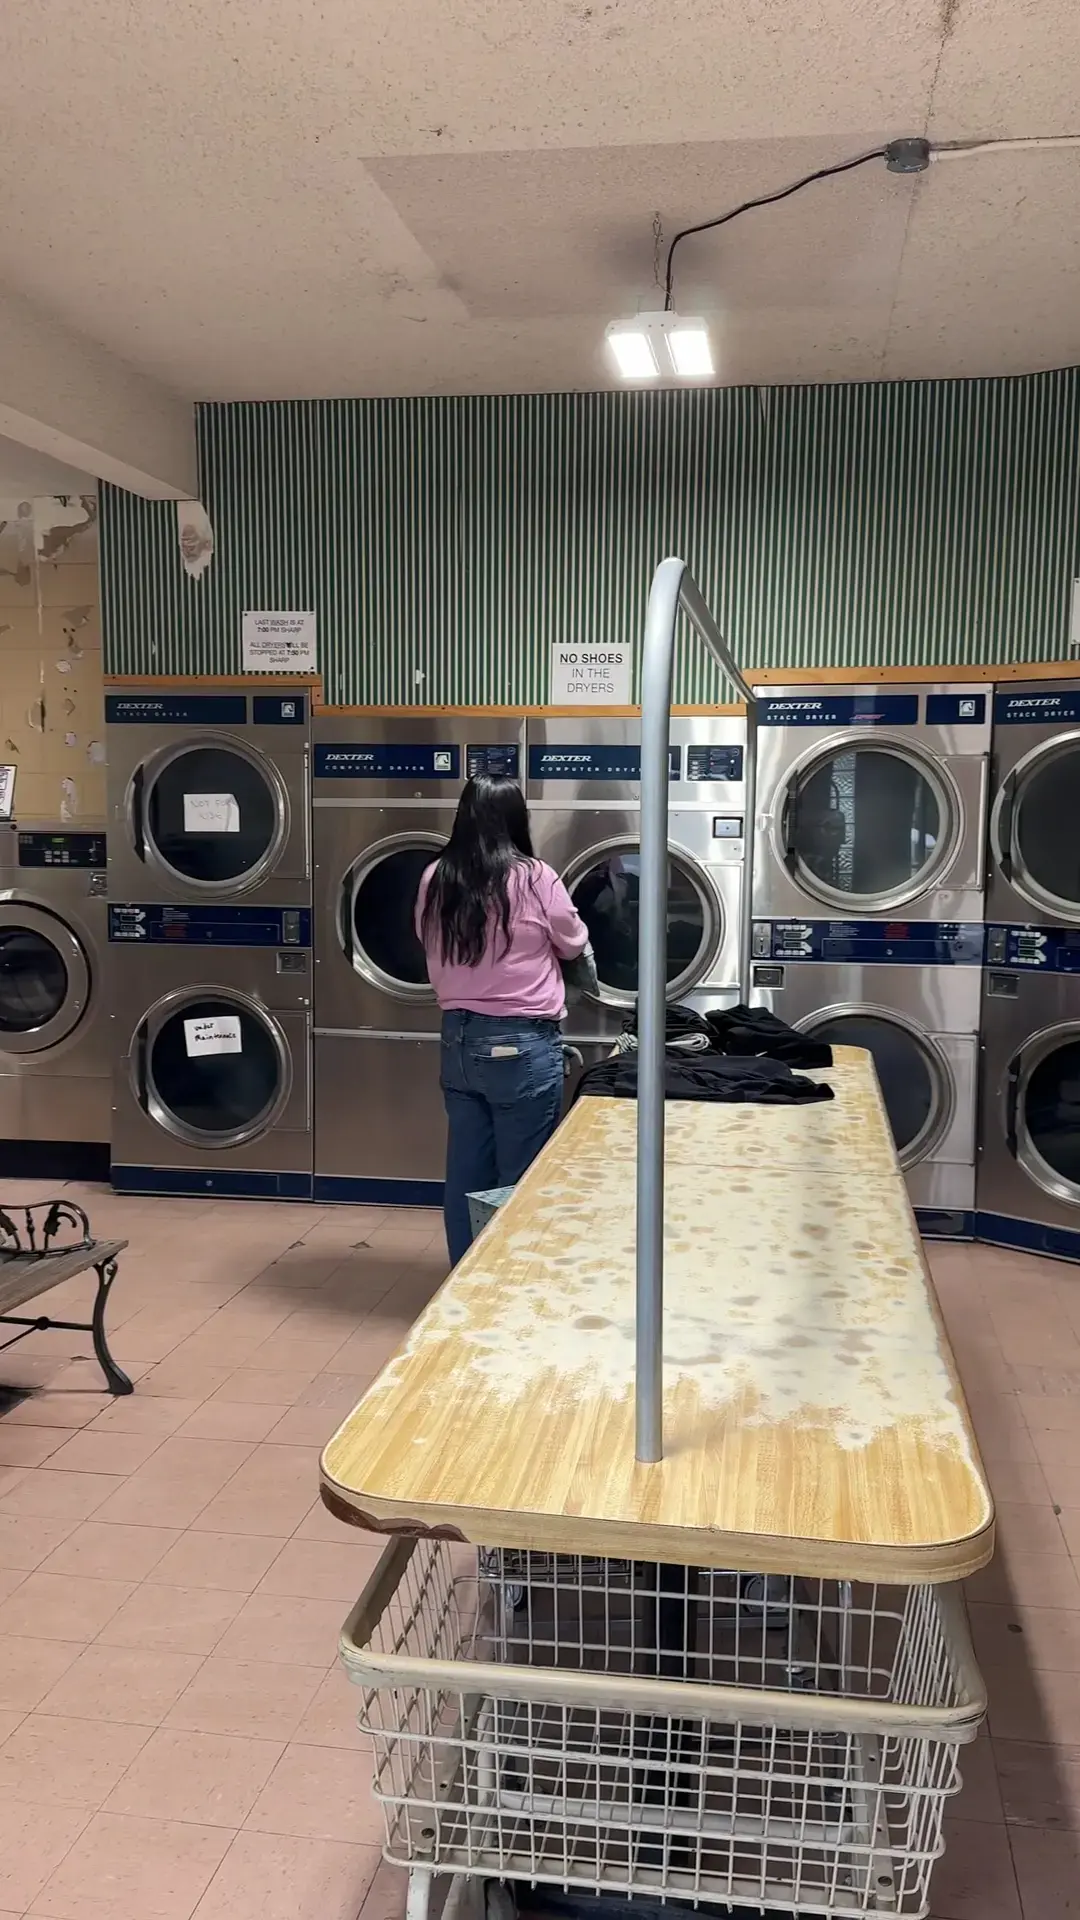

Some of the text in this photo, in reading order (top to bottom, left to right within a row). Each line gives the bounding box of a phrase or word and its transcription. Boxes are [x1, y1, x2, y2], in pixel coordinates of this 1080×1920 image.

[560, 653, 623, 664] NO SHOES
[572, 668, 610, 678] IN THE
[567, 682, 614, 693] DRYERS
[767, 702, 822, 710] DEXTER
[1007, 698, 1061, 707] DEXTER
